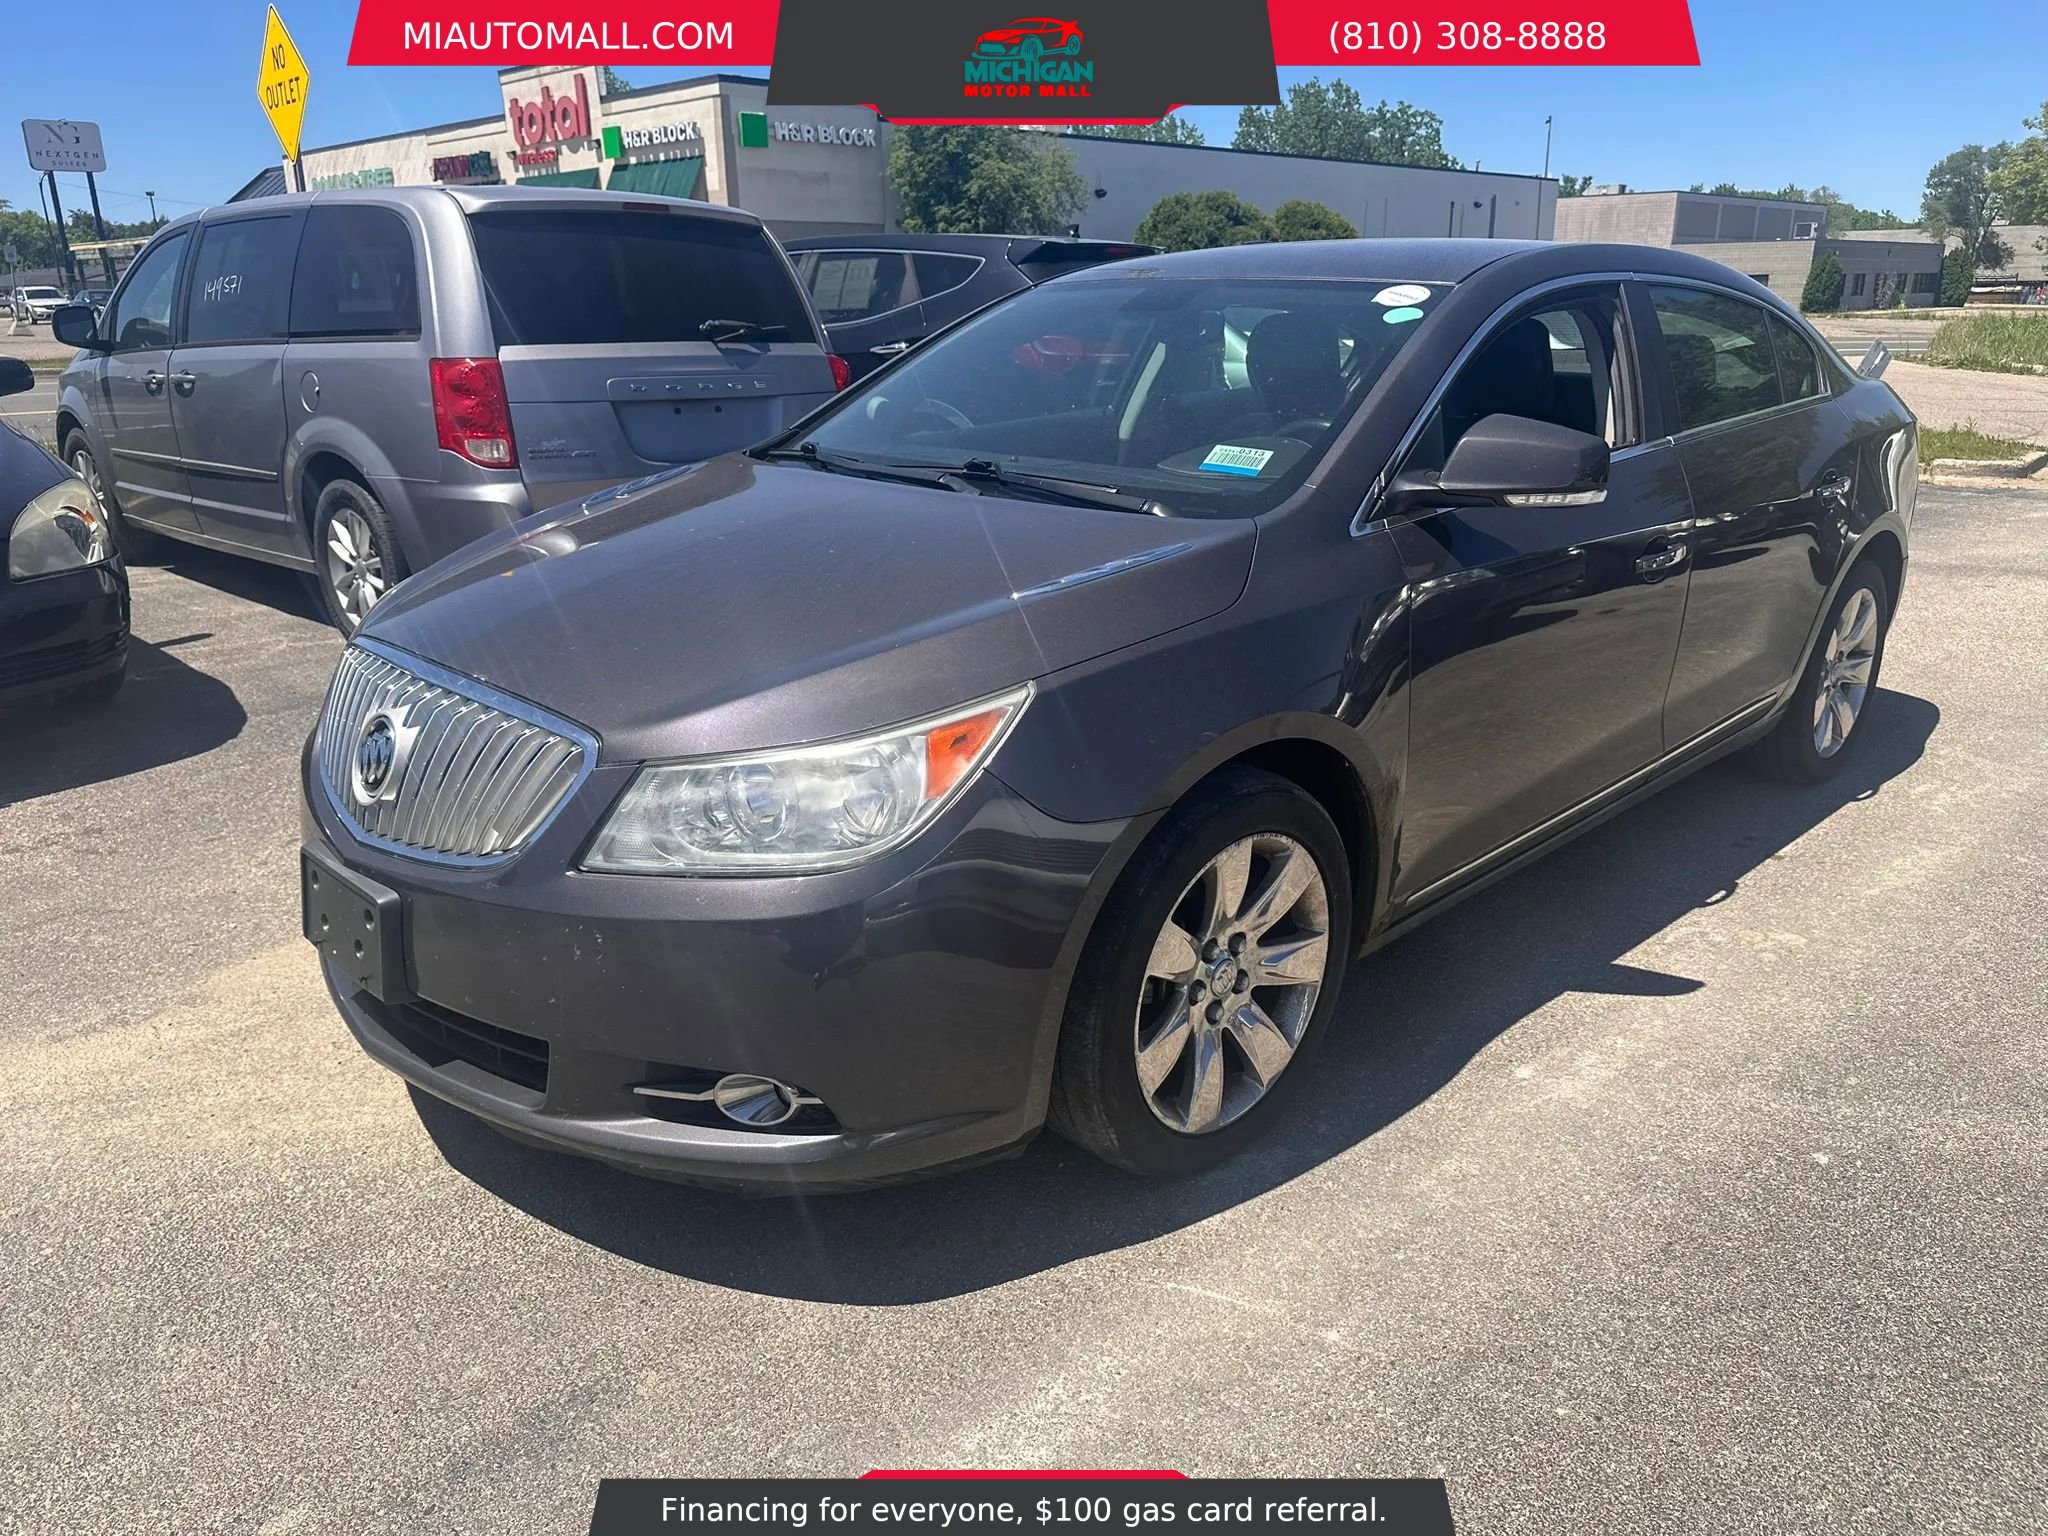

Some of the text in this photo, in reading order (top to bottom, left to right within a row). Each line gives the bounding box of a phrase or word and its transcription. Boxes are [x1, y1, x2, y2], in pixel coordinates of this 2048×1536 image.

[271, 43, 286, 71] NO
[265, 76, 301, 111] OUTLET
[509, 73, 591, 147] total
[623, 121, 696, 149] H&R BLOCK
[774, 121, 877, 148] H&R BLOCK
[35, 149, 99, 159] NEXTGEN
[51, 160, 88, 168] SUITES
[359, 167, 394, 189] TREE
[204, 274, 243, 302] 149571
